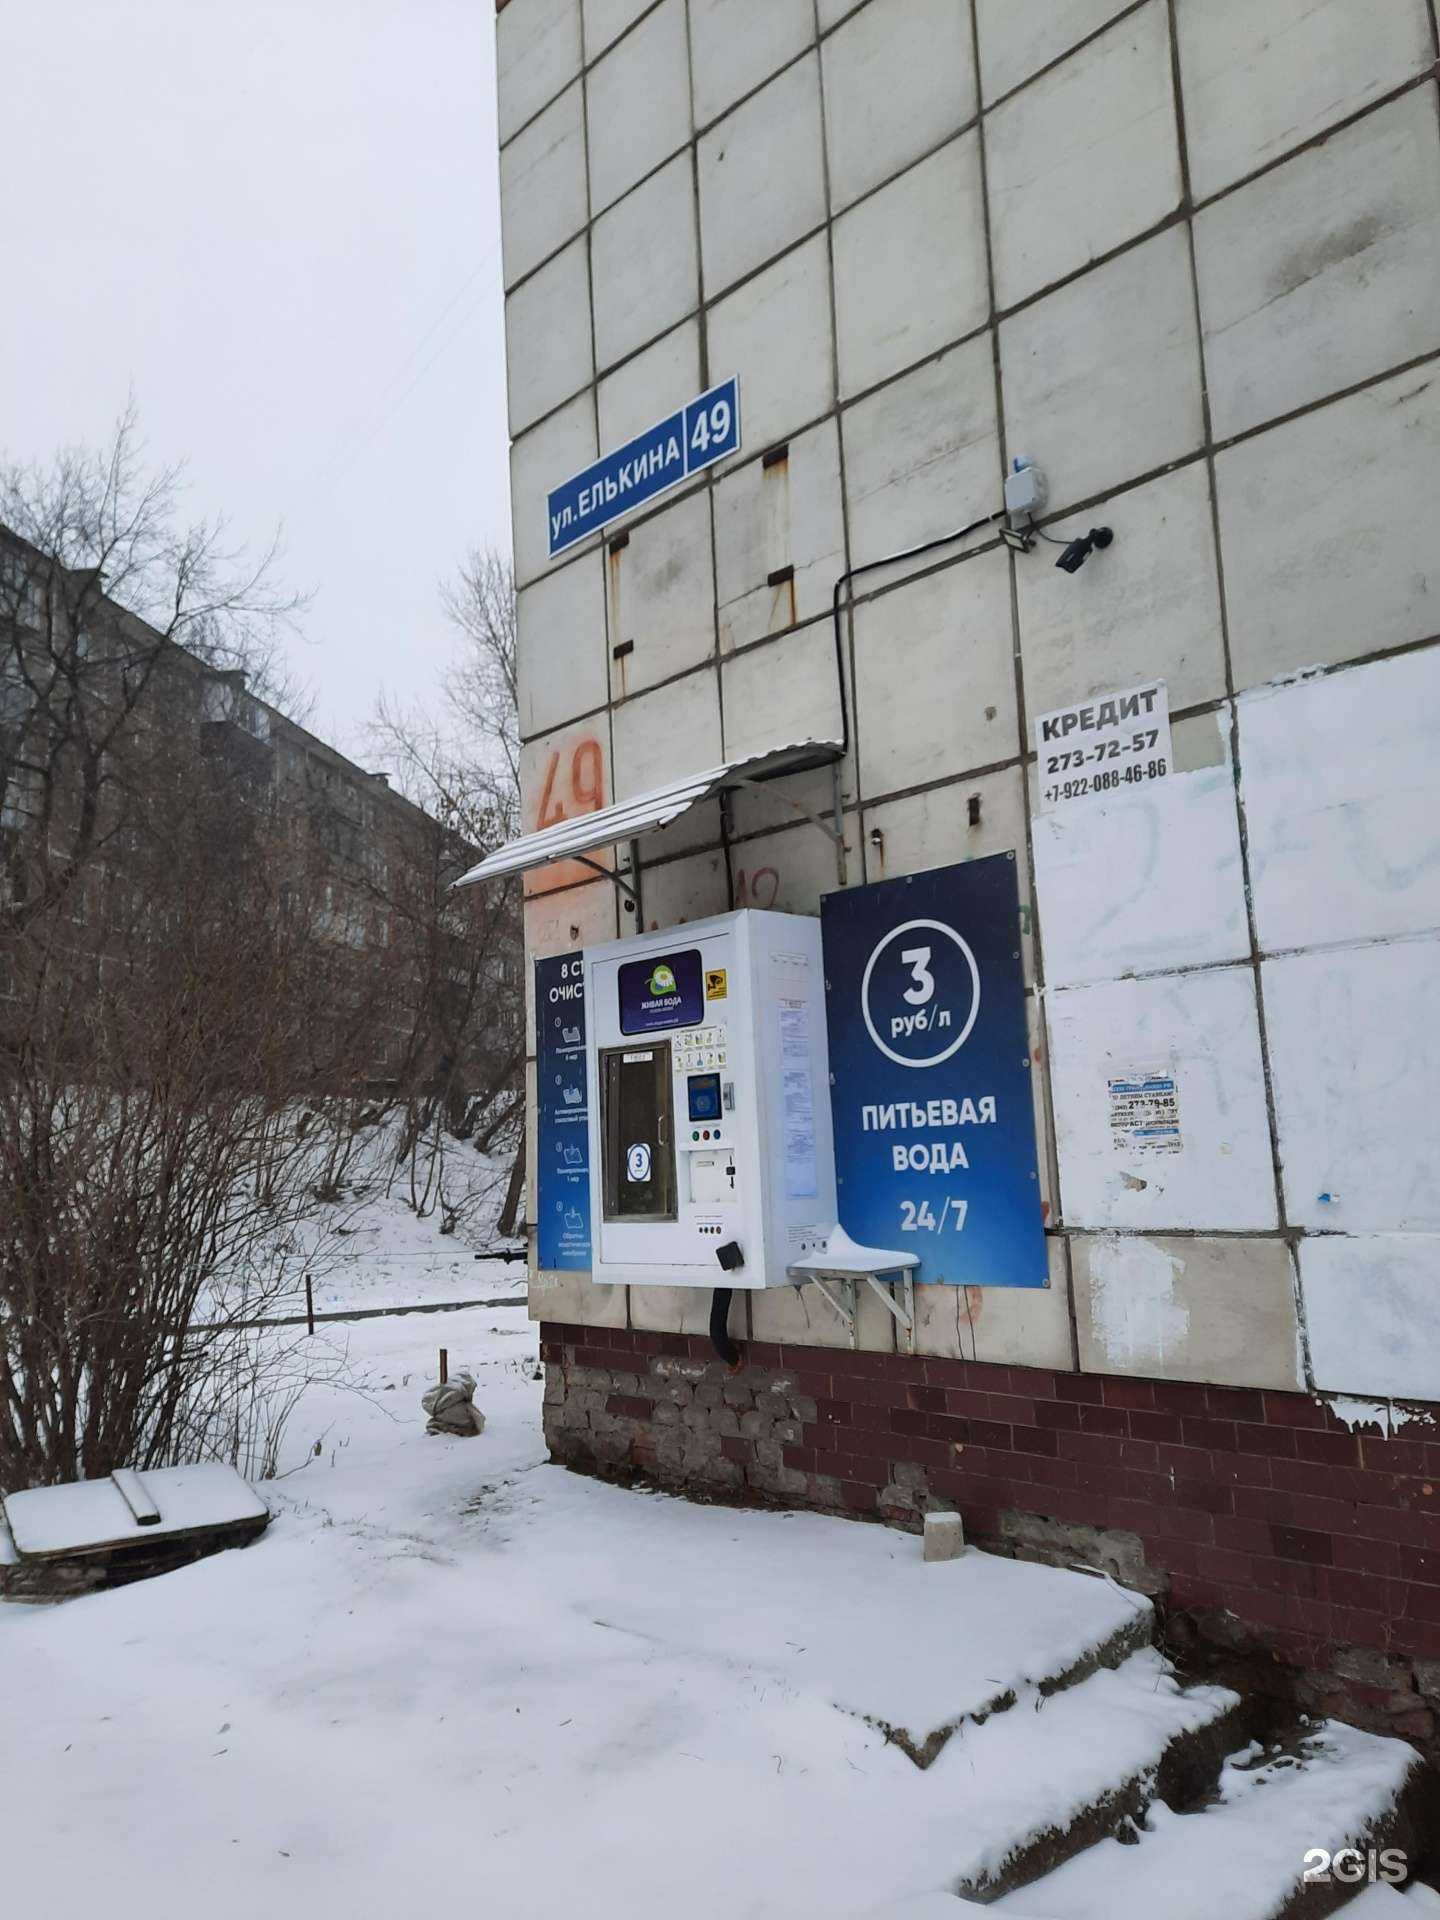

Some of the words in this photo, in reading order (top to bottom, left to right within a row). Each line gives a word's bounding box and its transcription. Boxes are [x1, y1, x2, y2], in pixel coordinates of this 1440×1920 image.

[691, 400, 731, 452] 49
[1042, 688, 1158, 742] КРЕДИТ
[1047, 729, 1159, 774] 273-72-57
[1044, 758, 1167, 802] +7-922-088-46-86
[561, 963, 569, 979] 8
[901, 946, 935, 1006] 3
[549, 981, 585, 1003] ОЧИС
[890, 1004, 951, 1038] руб/л
[862, 1096, 997, 1131] ПИТЬЕВАЯ
[635, 1153, 643, 1168] 3
[892, 1142, 969, 1174] ВОДА
[900, 1196, 968, 1235] 24/7
